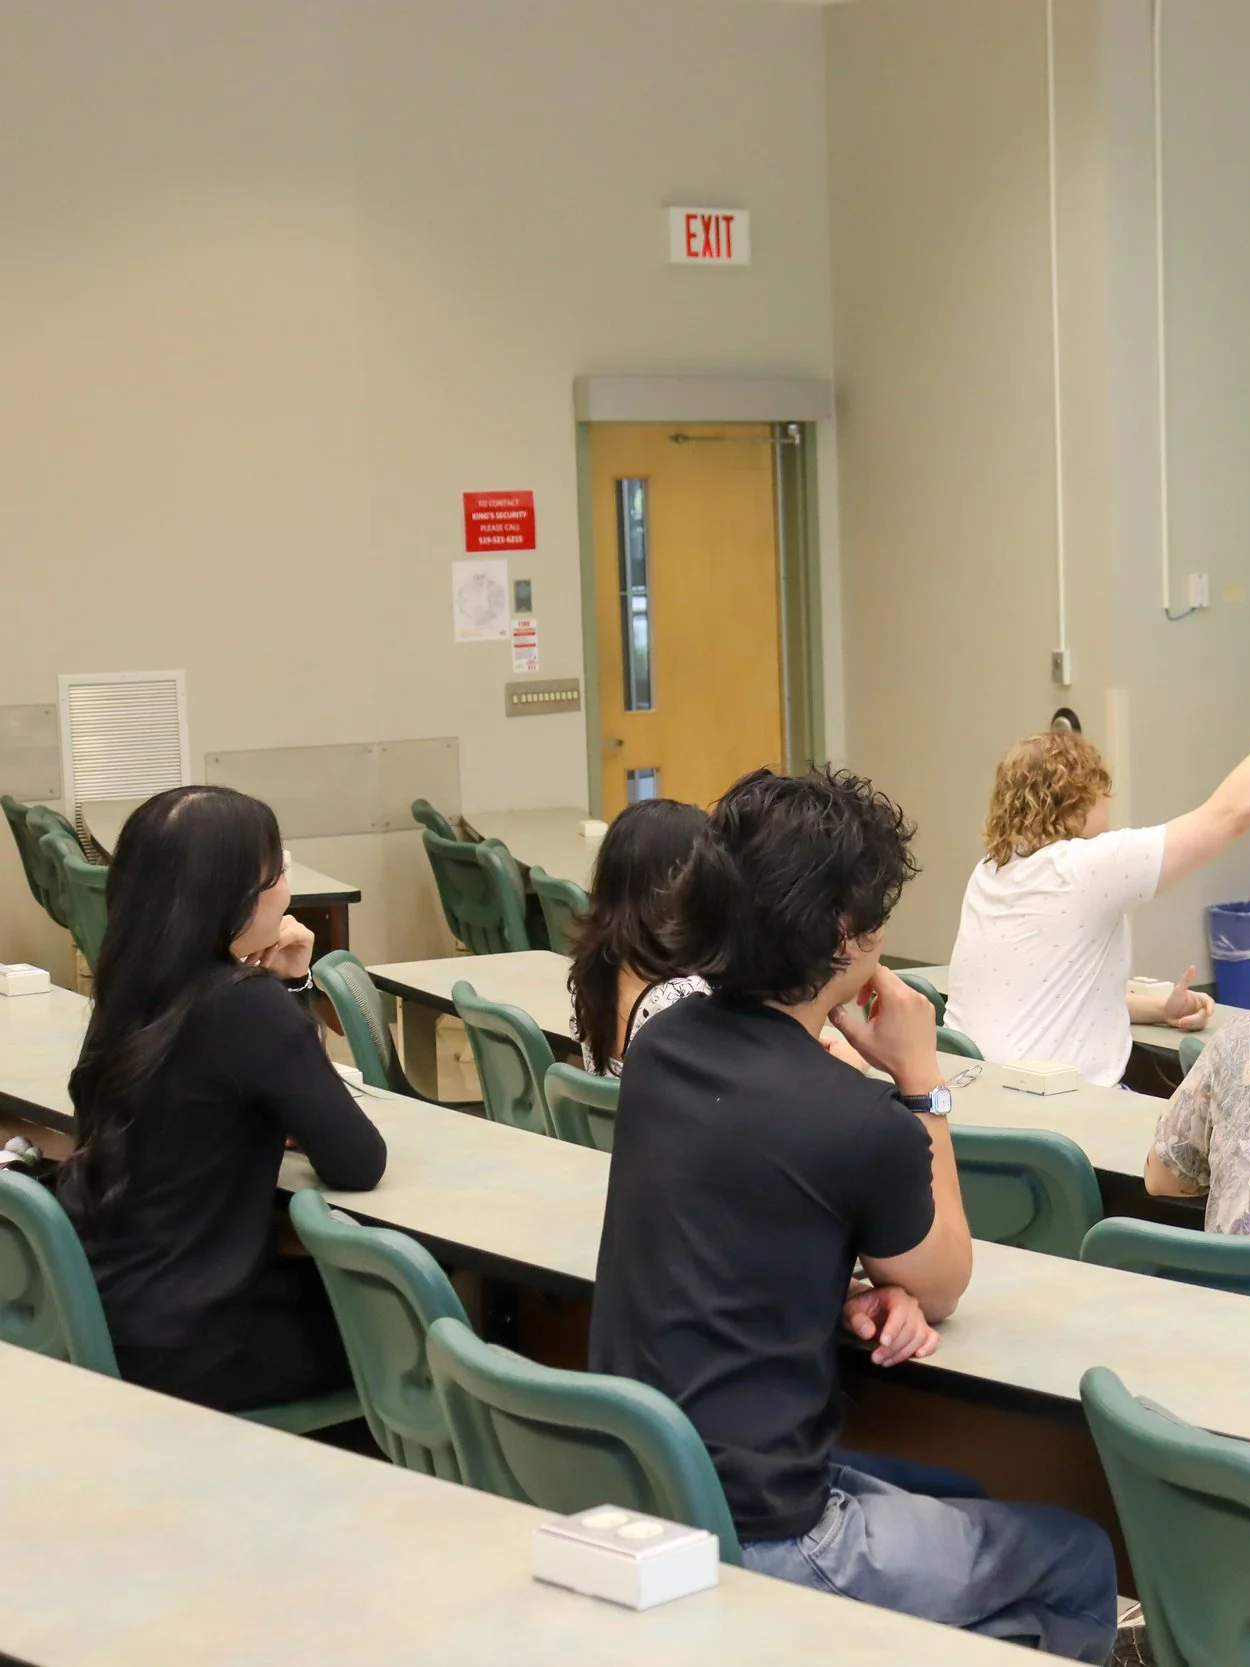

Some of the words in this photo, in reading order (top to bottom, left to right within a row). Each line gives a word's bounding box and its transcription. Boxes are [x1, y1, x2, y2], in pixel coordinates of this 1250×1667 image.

[685, 213, 734, 258] EXIT
[488, 498, 520, 508] CONTACT
[472, 511, 495, 520] KING'S
[495, 510, 528, 520] SECURITY
[480, 523, 504, 532] PLEASE
[504, 523, 520, 532] CALL
